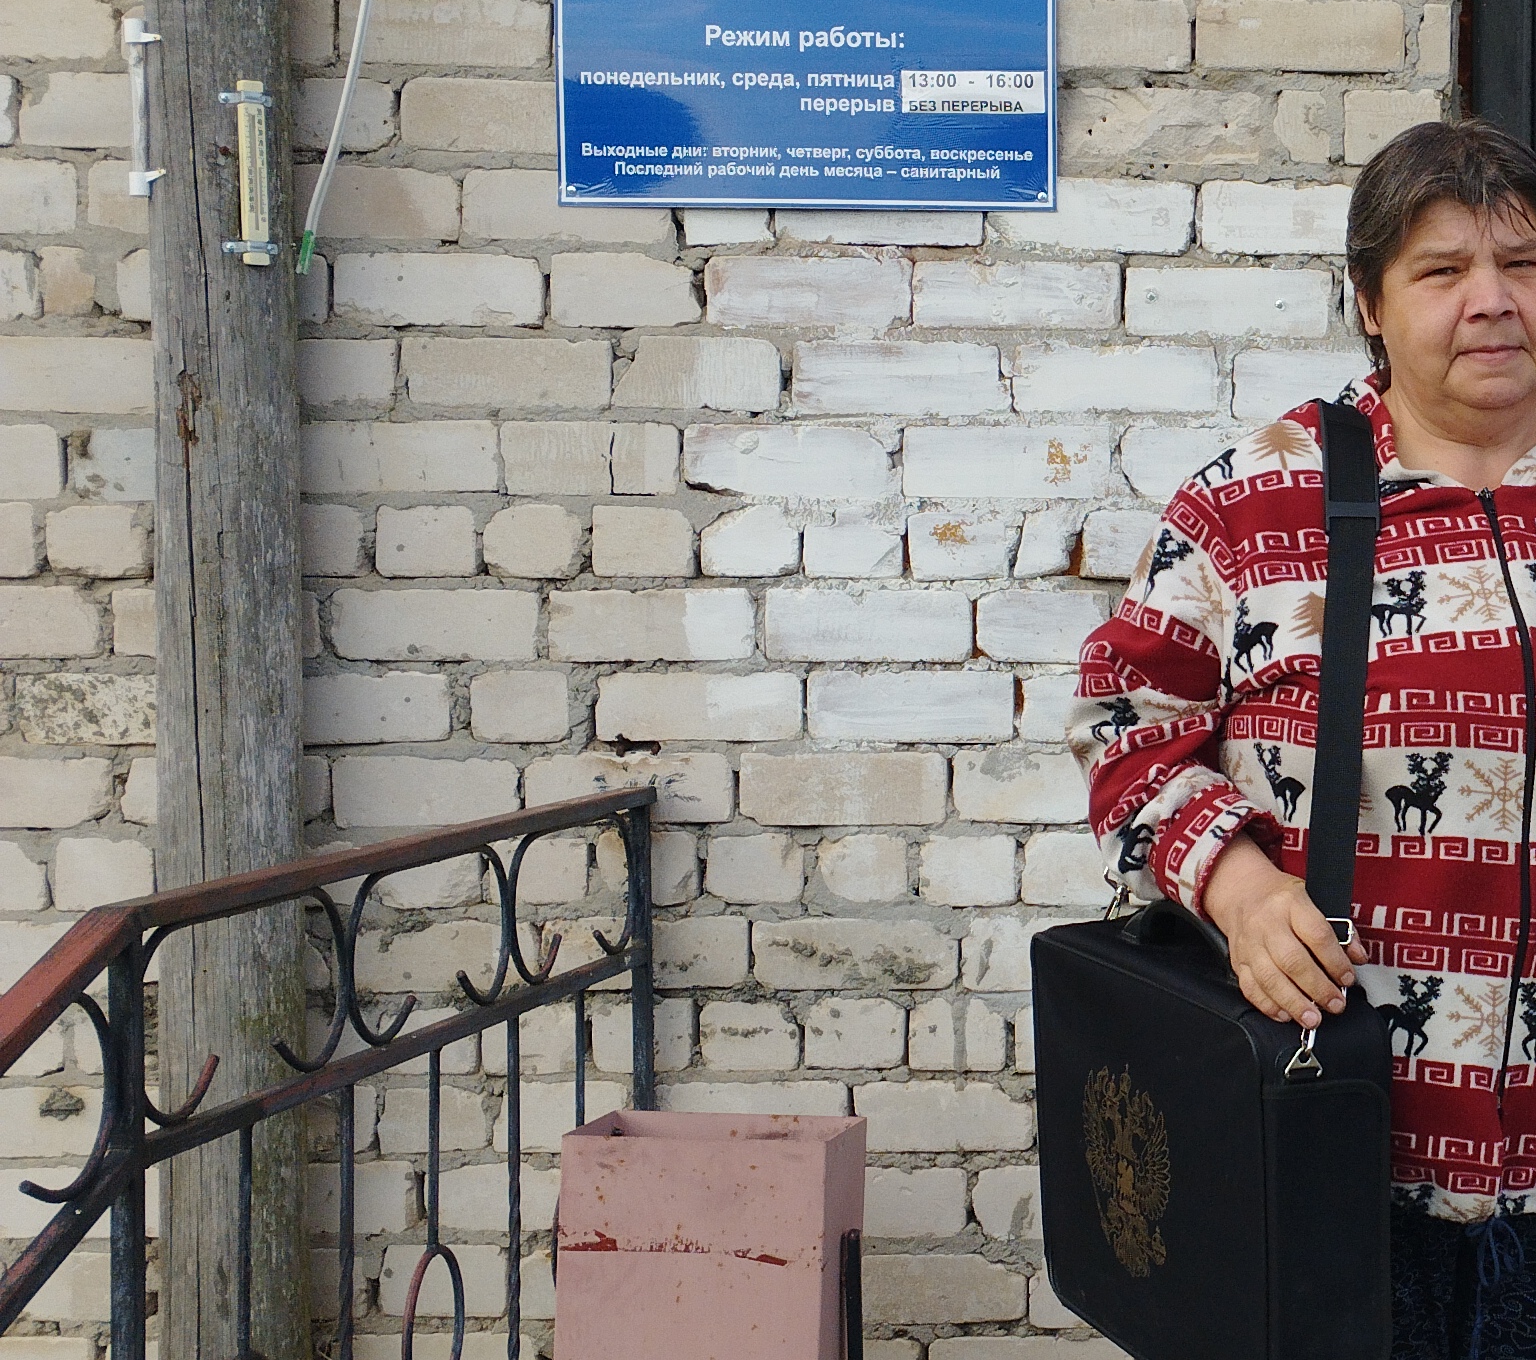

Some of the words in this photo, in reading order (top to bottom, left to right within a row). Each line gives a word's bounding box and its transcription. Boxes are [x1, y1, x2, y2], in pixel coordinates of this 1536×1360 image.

[705, 25, 790, 47] Режим
[799, 26, 905, 52] работы:
[580, 71, 726, 88] понедельник,
[732, 72, 800, 90] среда,
[807, 73, 895, 90] пятница
[908, 73, 957, 88] 13:00
[986, 73, 1034, 88] 16:00
[800, 97, 895, 116] перерыв
[909, 100, 936, 112] БЕЗ
[941, 100, 1024, 112] ПЕРЕРЫВА
[581, 142, 668, 158] Выходные
[671, 146, 708, 159] дни:
[712, 146, 782, 160] вторник,
[787, 146, 850, 161] четверг,
[856, 146, 926, 162] суббота,
[930, 150, 1033, 162] воскресенье
[614, 161, 703, 178] Последний
[708, 161, 775, 178] рабочий
[779, 165, 819, 178] день
[824, 166, 882, 180] месяца
[901, 166, 1001, 181] санитарный
